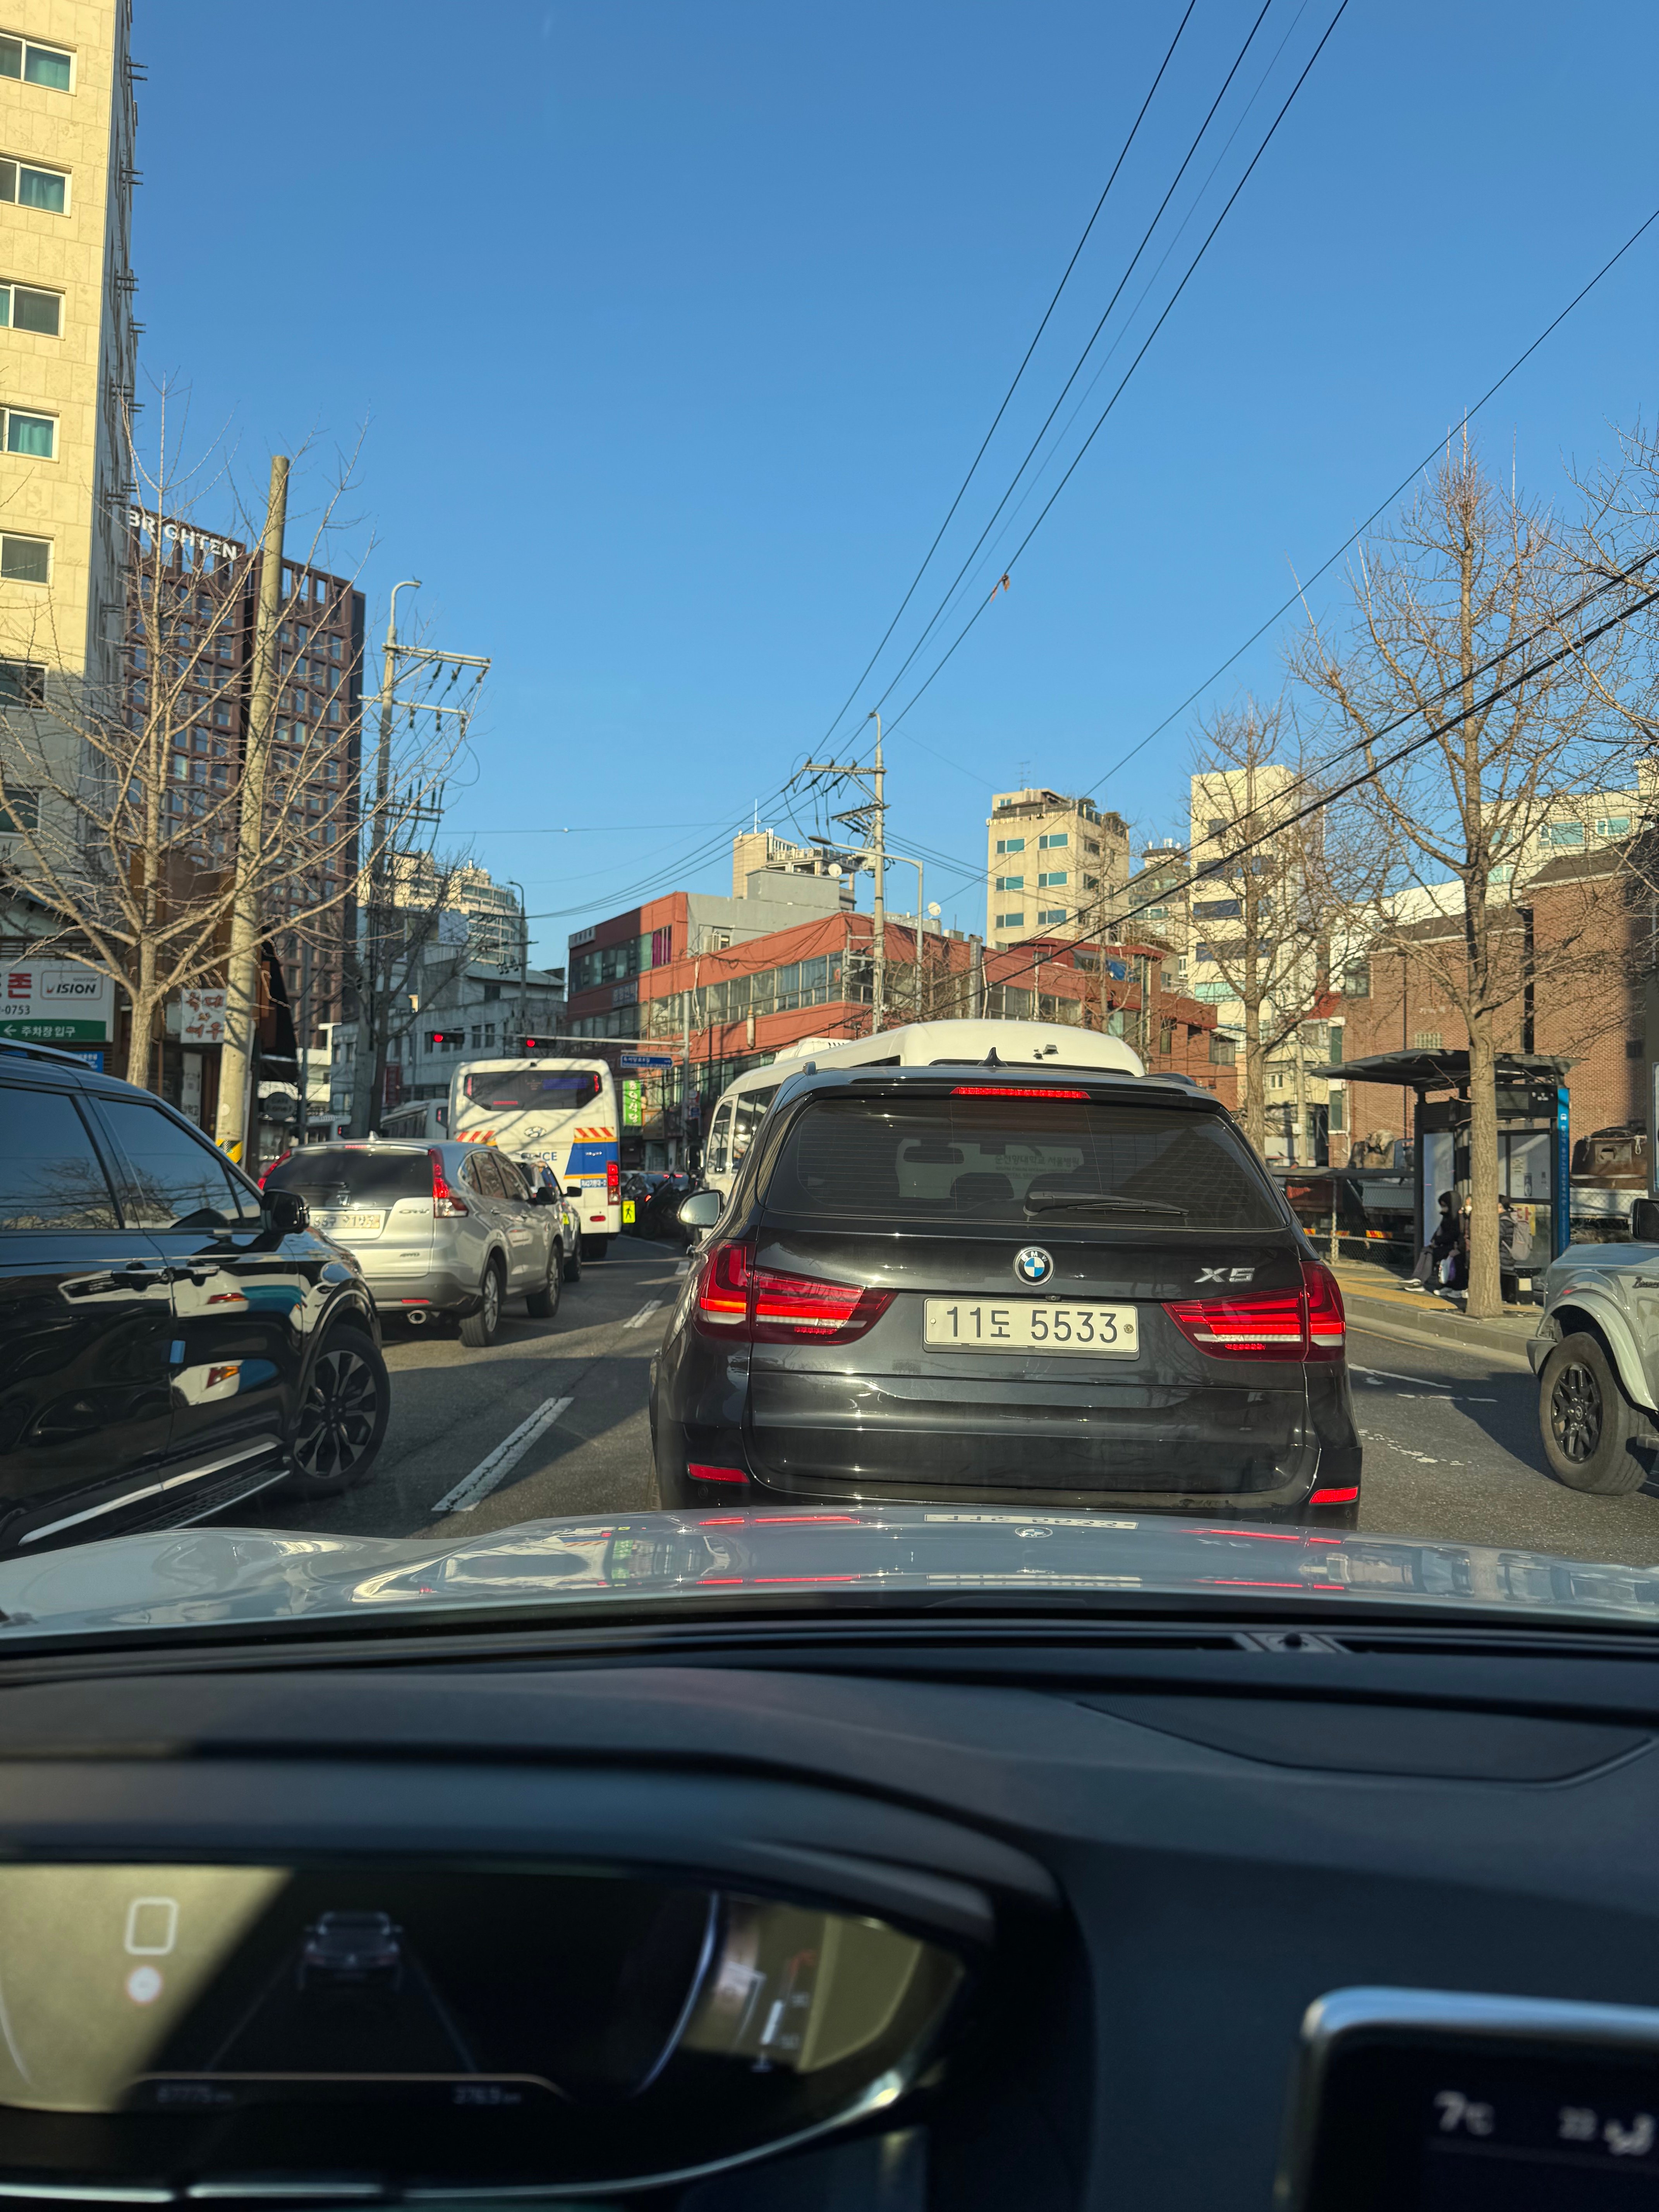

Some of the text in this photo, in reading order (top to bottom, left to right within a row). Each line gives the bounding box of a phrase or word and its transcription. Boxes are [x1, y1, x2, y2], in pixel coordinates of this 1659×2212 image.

[129, 509, 237, 560] BRGHTEN
[0, 973, 32, 999] 존
[0, 1005, 30, 1015] -0753
[1194, 1268, 1255, 1282] X5
[947, 1306, 1117, 1343] 11도 5533
